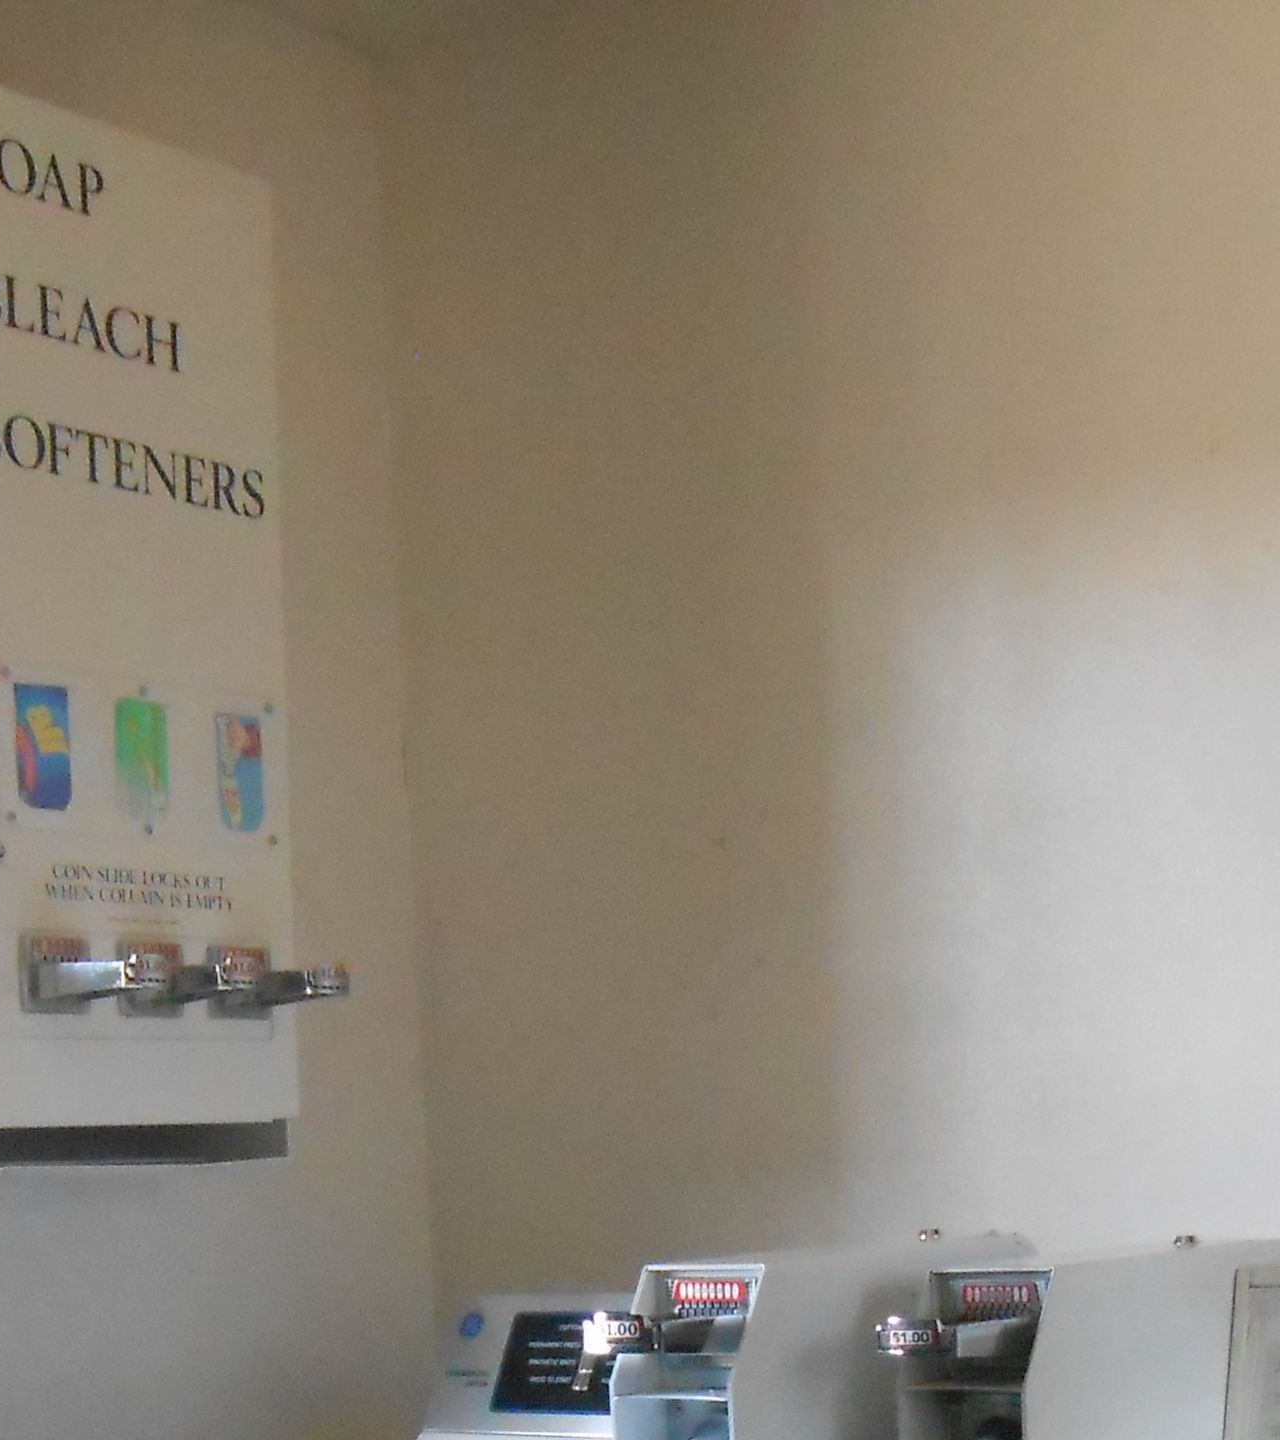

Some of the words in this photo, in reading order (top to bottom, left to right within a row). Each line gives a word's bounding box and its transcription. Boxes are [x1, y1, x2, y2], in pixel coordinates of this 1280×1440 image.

[52, 864, 92, 881] COIN
[97, 866, 136, 884] SLIDE
[141, 869, 191, 888] LOCKS
[194, 874, 225, 892] OUT
[45, 882, 95, 902] WHEN
[99, 887, 165, 906] COLUMN
[169, 893, 183, 908] IS
[187, 893, 234, 911] EMPTY
